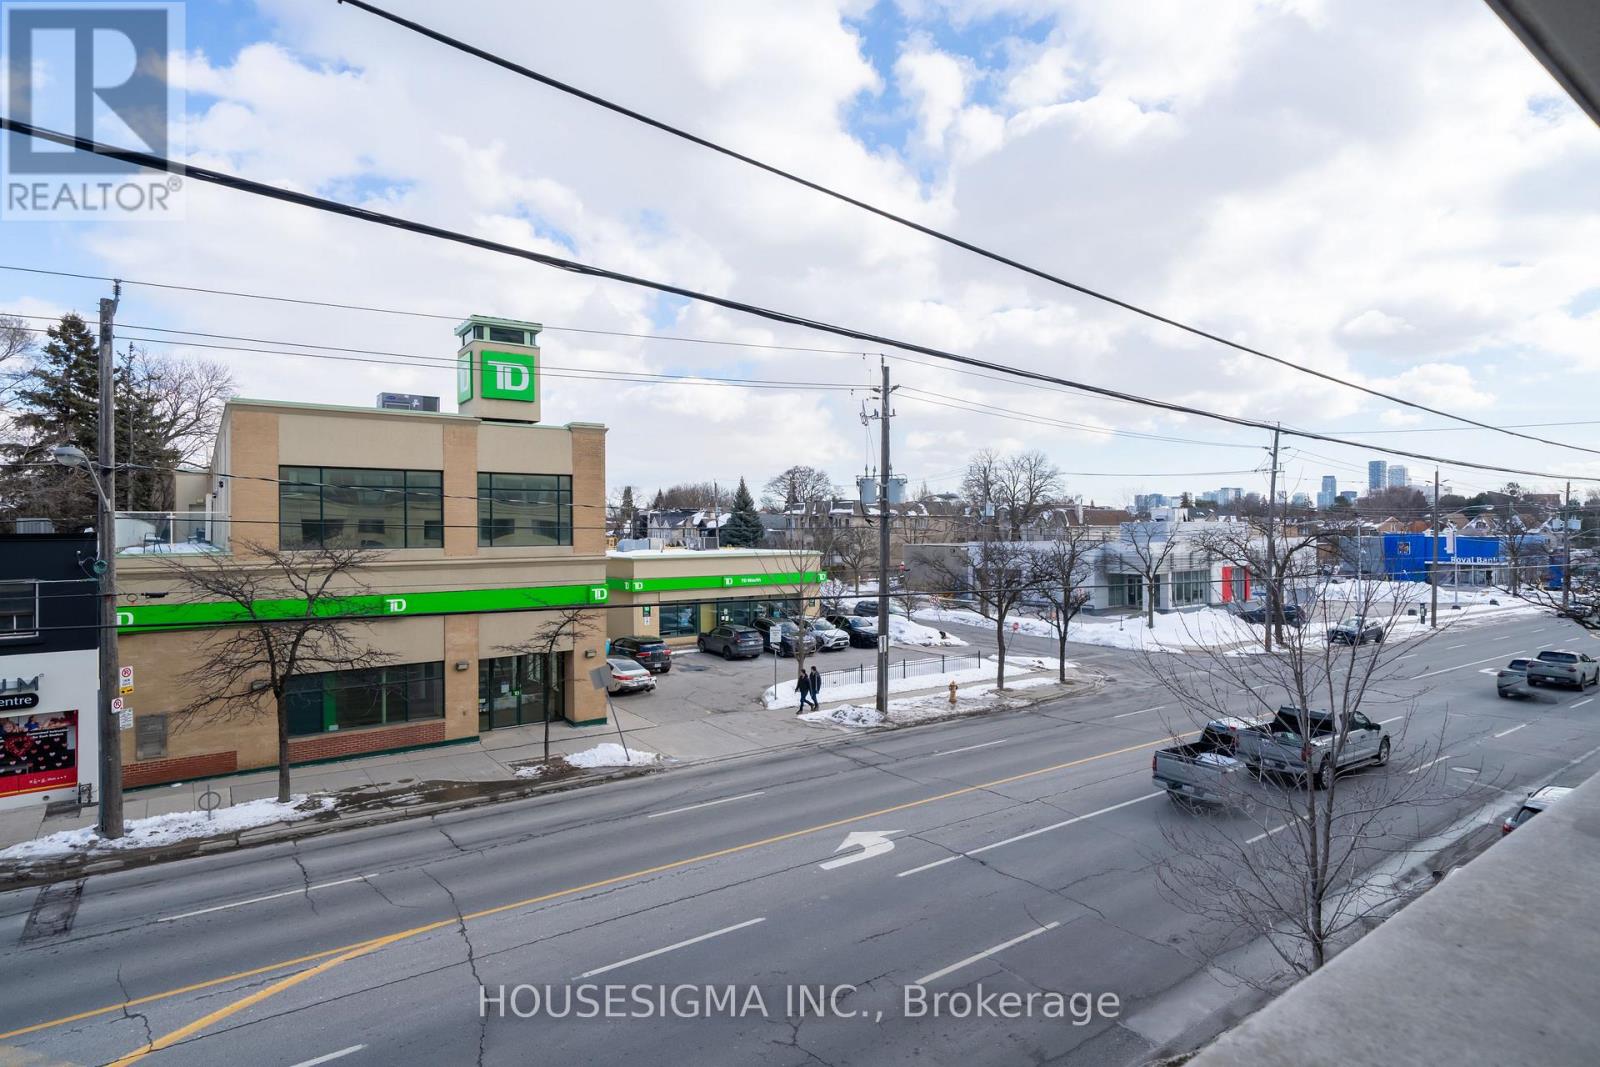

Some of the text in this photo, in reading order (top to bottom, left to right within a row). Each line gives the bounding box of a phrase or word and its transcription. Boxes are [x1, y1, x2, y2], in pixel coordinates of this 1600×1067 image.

[487, 360, 530, 391] TD
[633, 581, 643, 590] TD
[723, 577, 733, 585] TD
[591, 587, 608, 601] TD
[386, 598, 407, 612] TD
[116, 611, 134, 626] D
